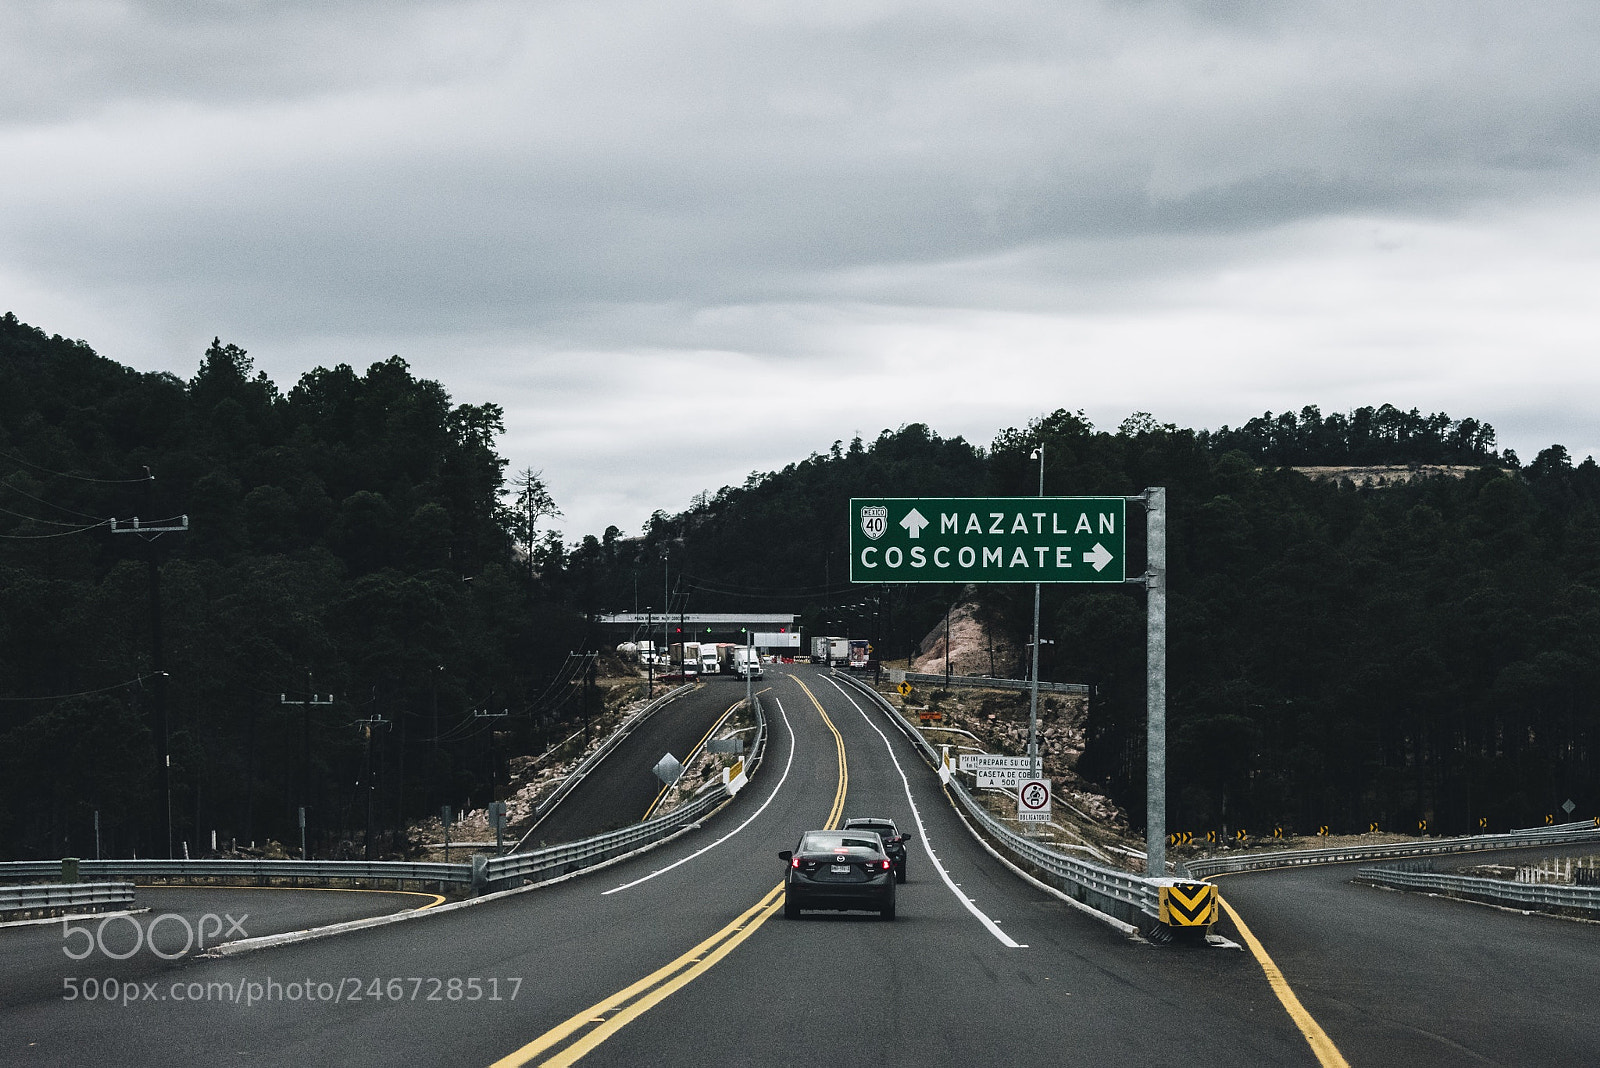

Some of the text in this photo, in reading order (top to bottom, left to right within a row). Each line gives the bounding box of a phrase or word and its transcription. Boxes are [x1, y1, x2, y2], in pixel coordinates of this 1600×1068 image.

[866, 518, 882, 532] 40
[940, 512, 1115, 534] MAZATLAN
[861, 546, 1072, 568] COSCOMATE
